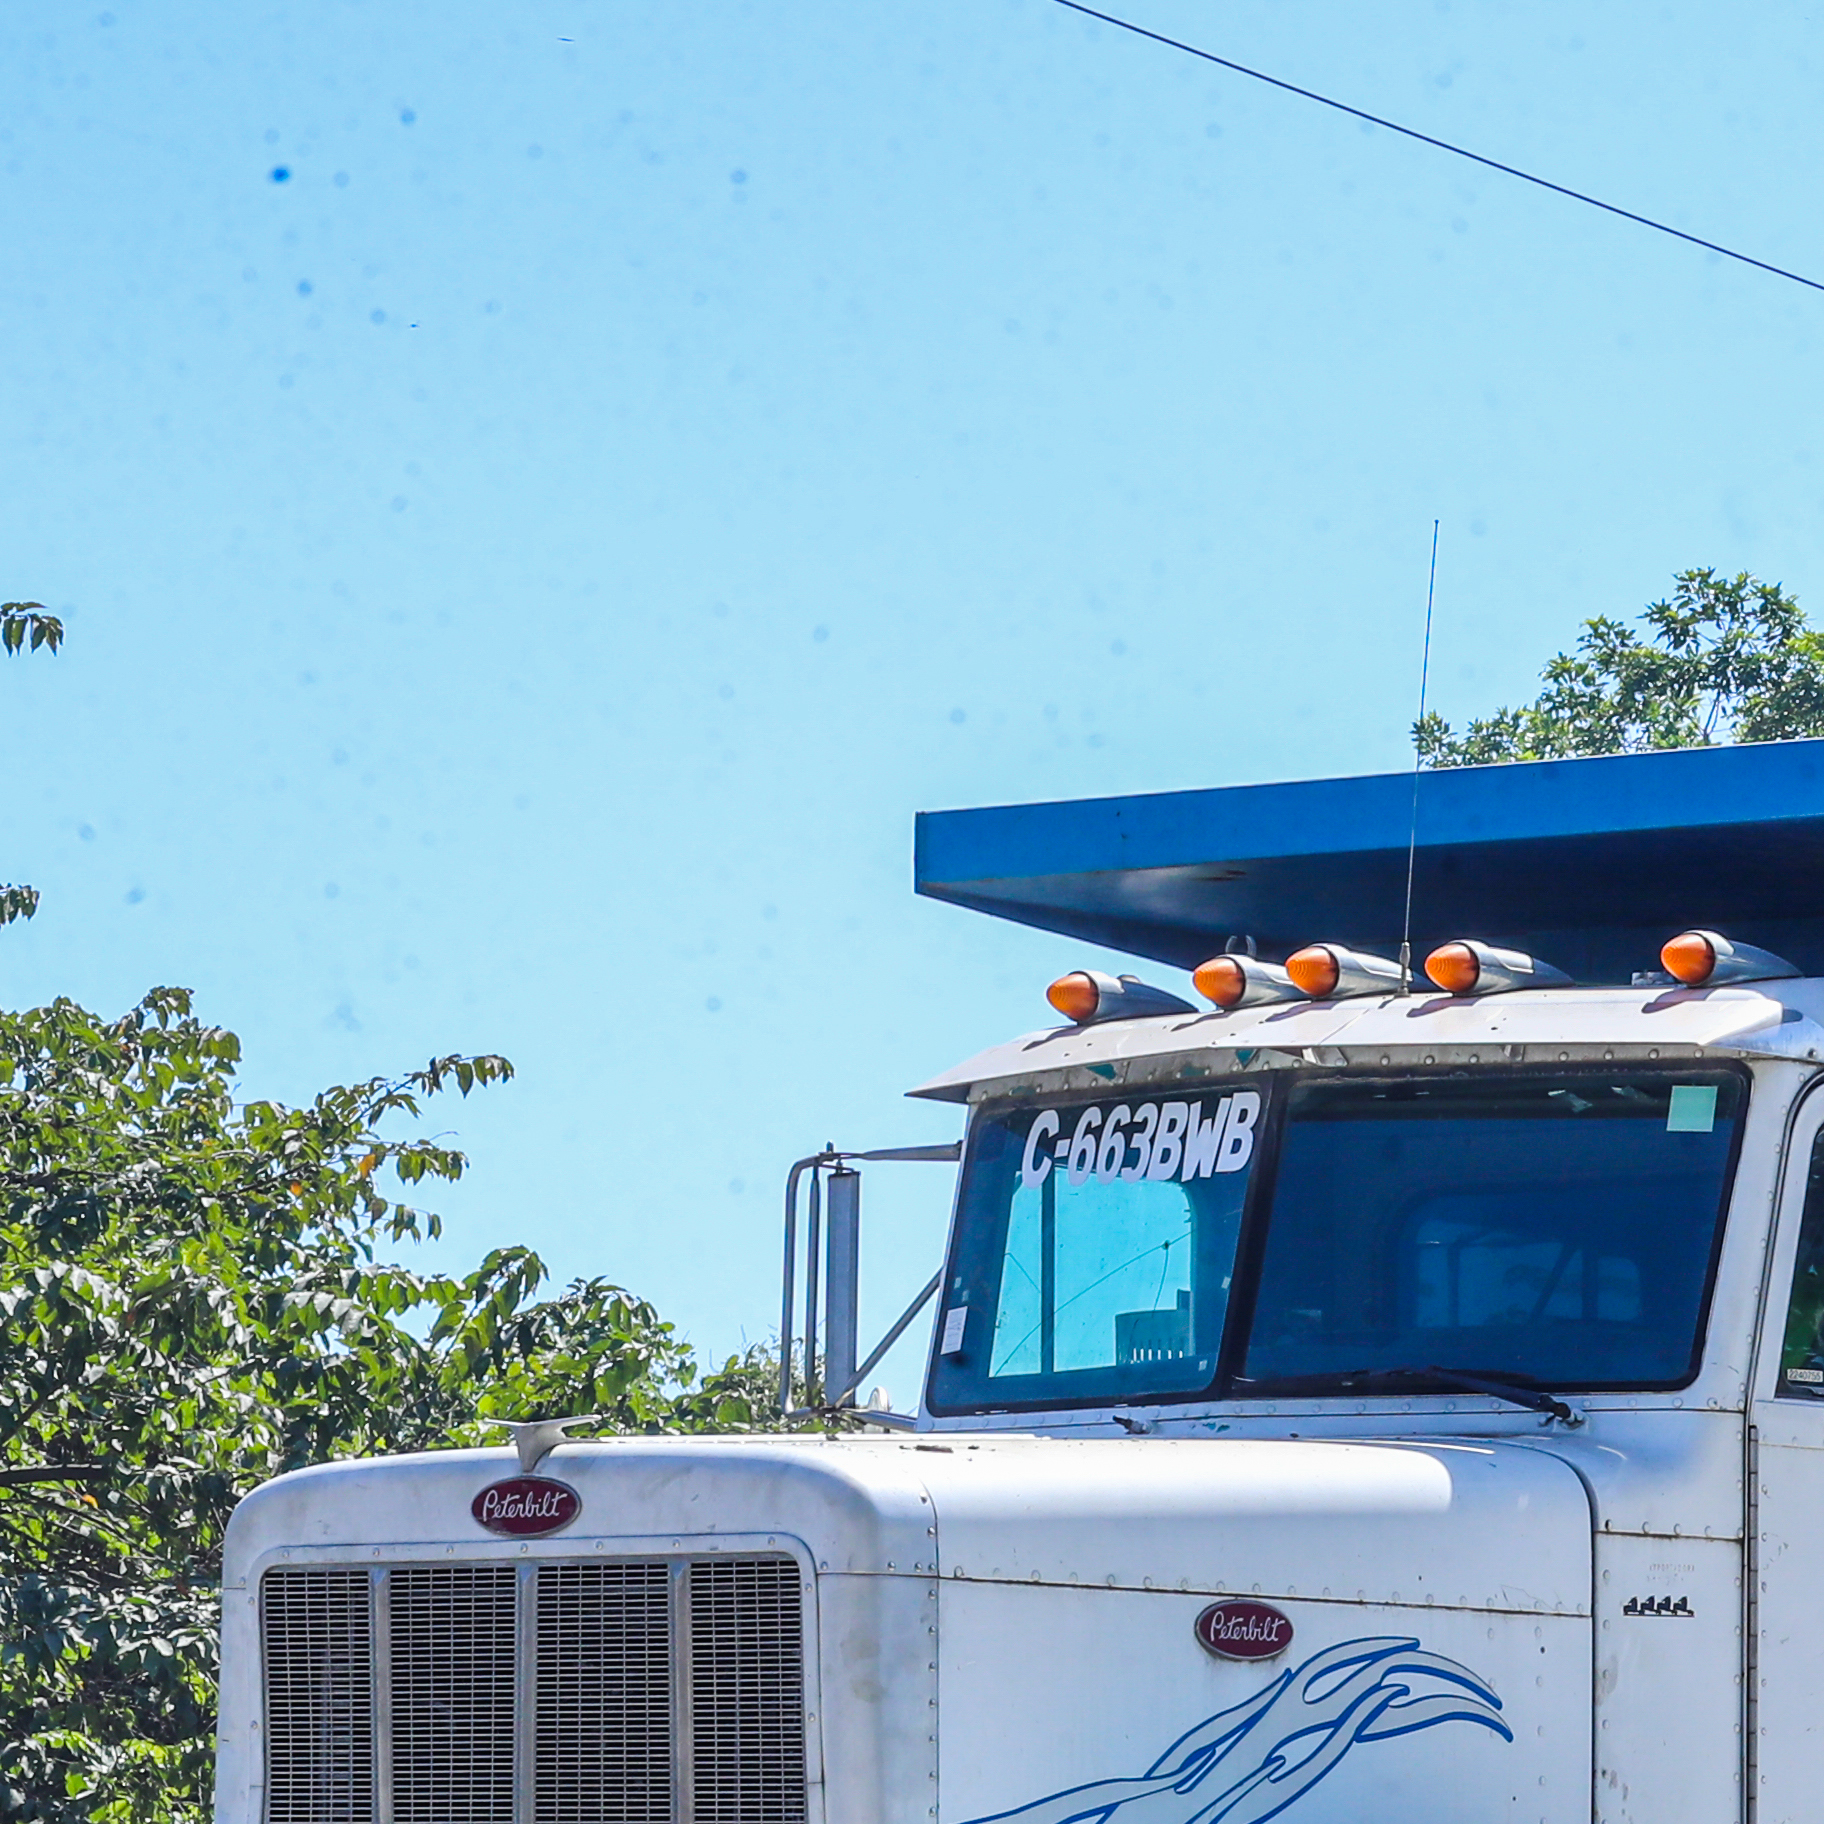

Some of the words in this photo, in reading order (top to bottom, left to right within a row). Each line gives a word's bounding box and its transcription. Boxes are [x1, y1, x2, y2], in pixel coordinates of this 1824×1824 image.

[1022, 1091, 1261, 1189] C-663BWB
[482, 1489, 568, 1522] Peterbilt
[1210, 1611, 1286, 1642] Peterbilt
